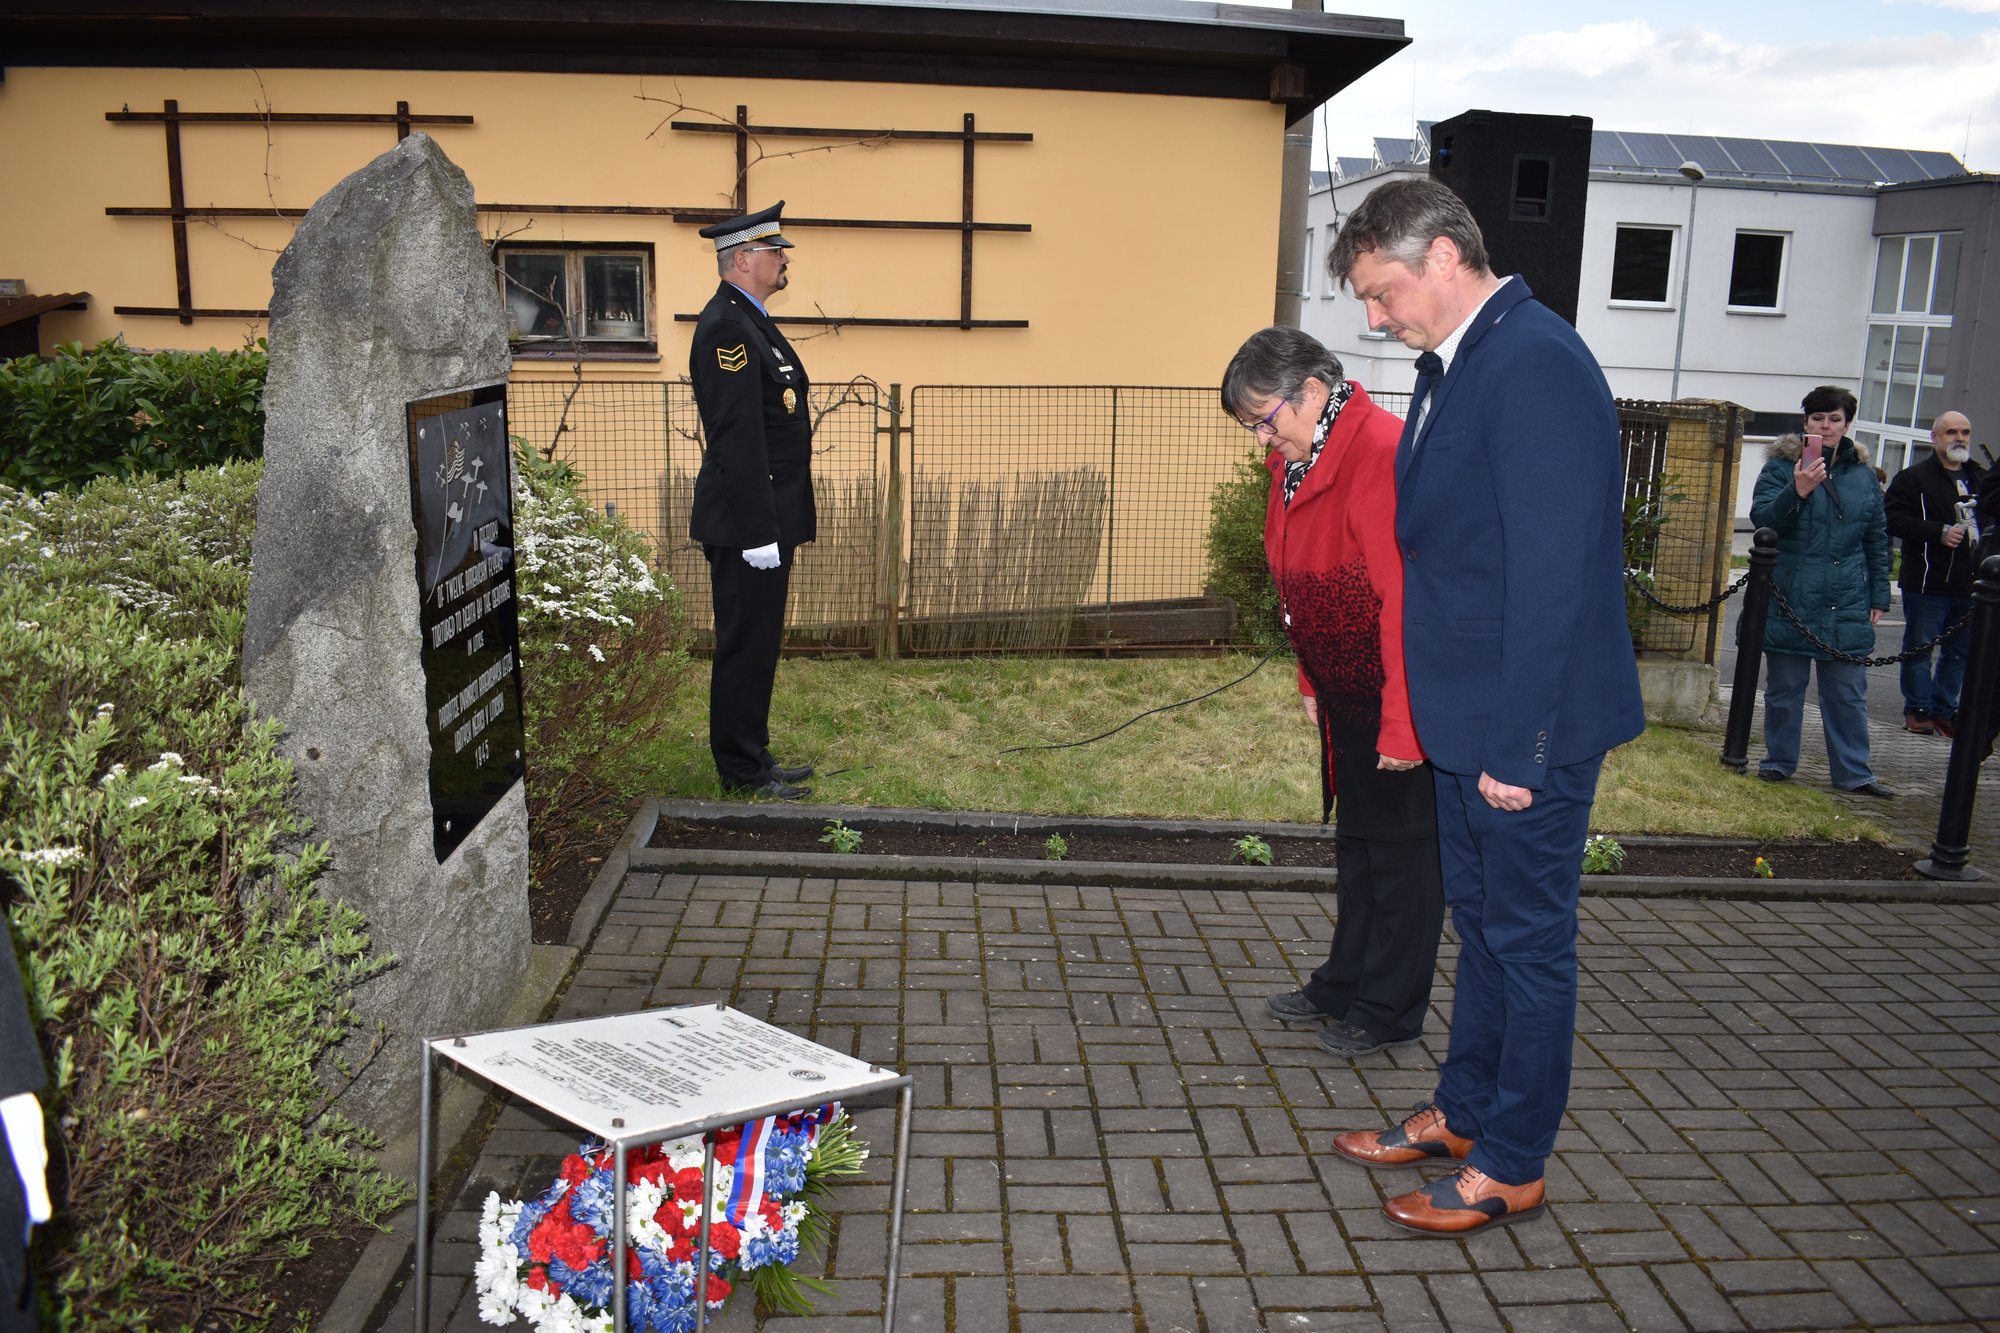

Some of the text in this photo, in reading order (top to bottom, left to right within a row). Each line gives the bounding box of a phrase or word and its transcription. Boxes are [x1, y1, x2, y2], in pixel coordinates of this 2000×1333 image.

[437, 551, 504, 608] OF TWELVE AMERICAN FLYERS
[432, 579, 510, 650] TORTURED TO DEATH BY THE GERMANS
[475, 739, 490, 769] 1945
